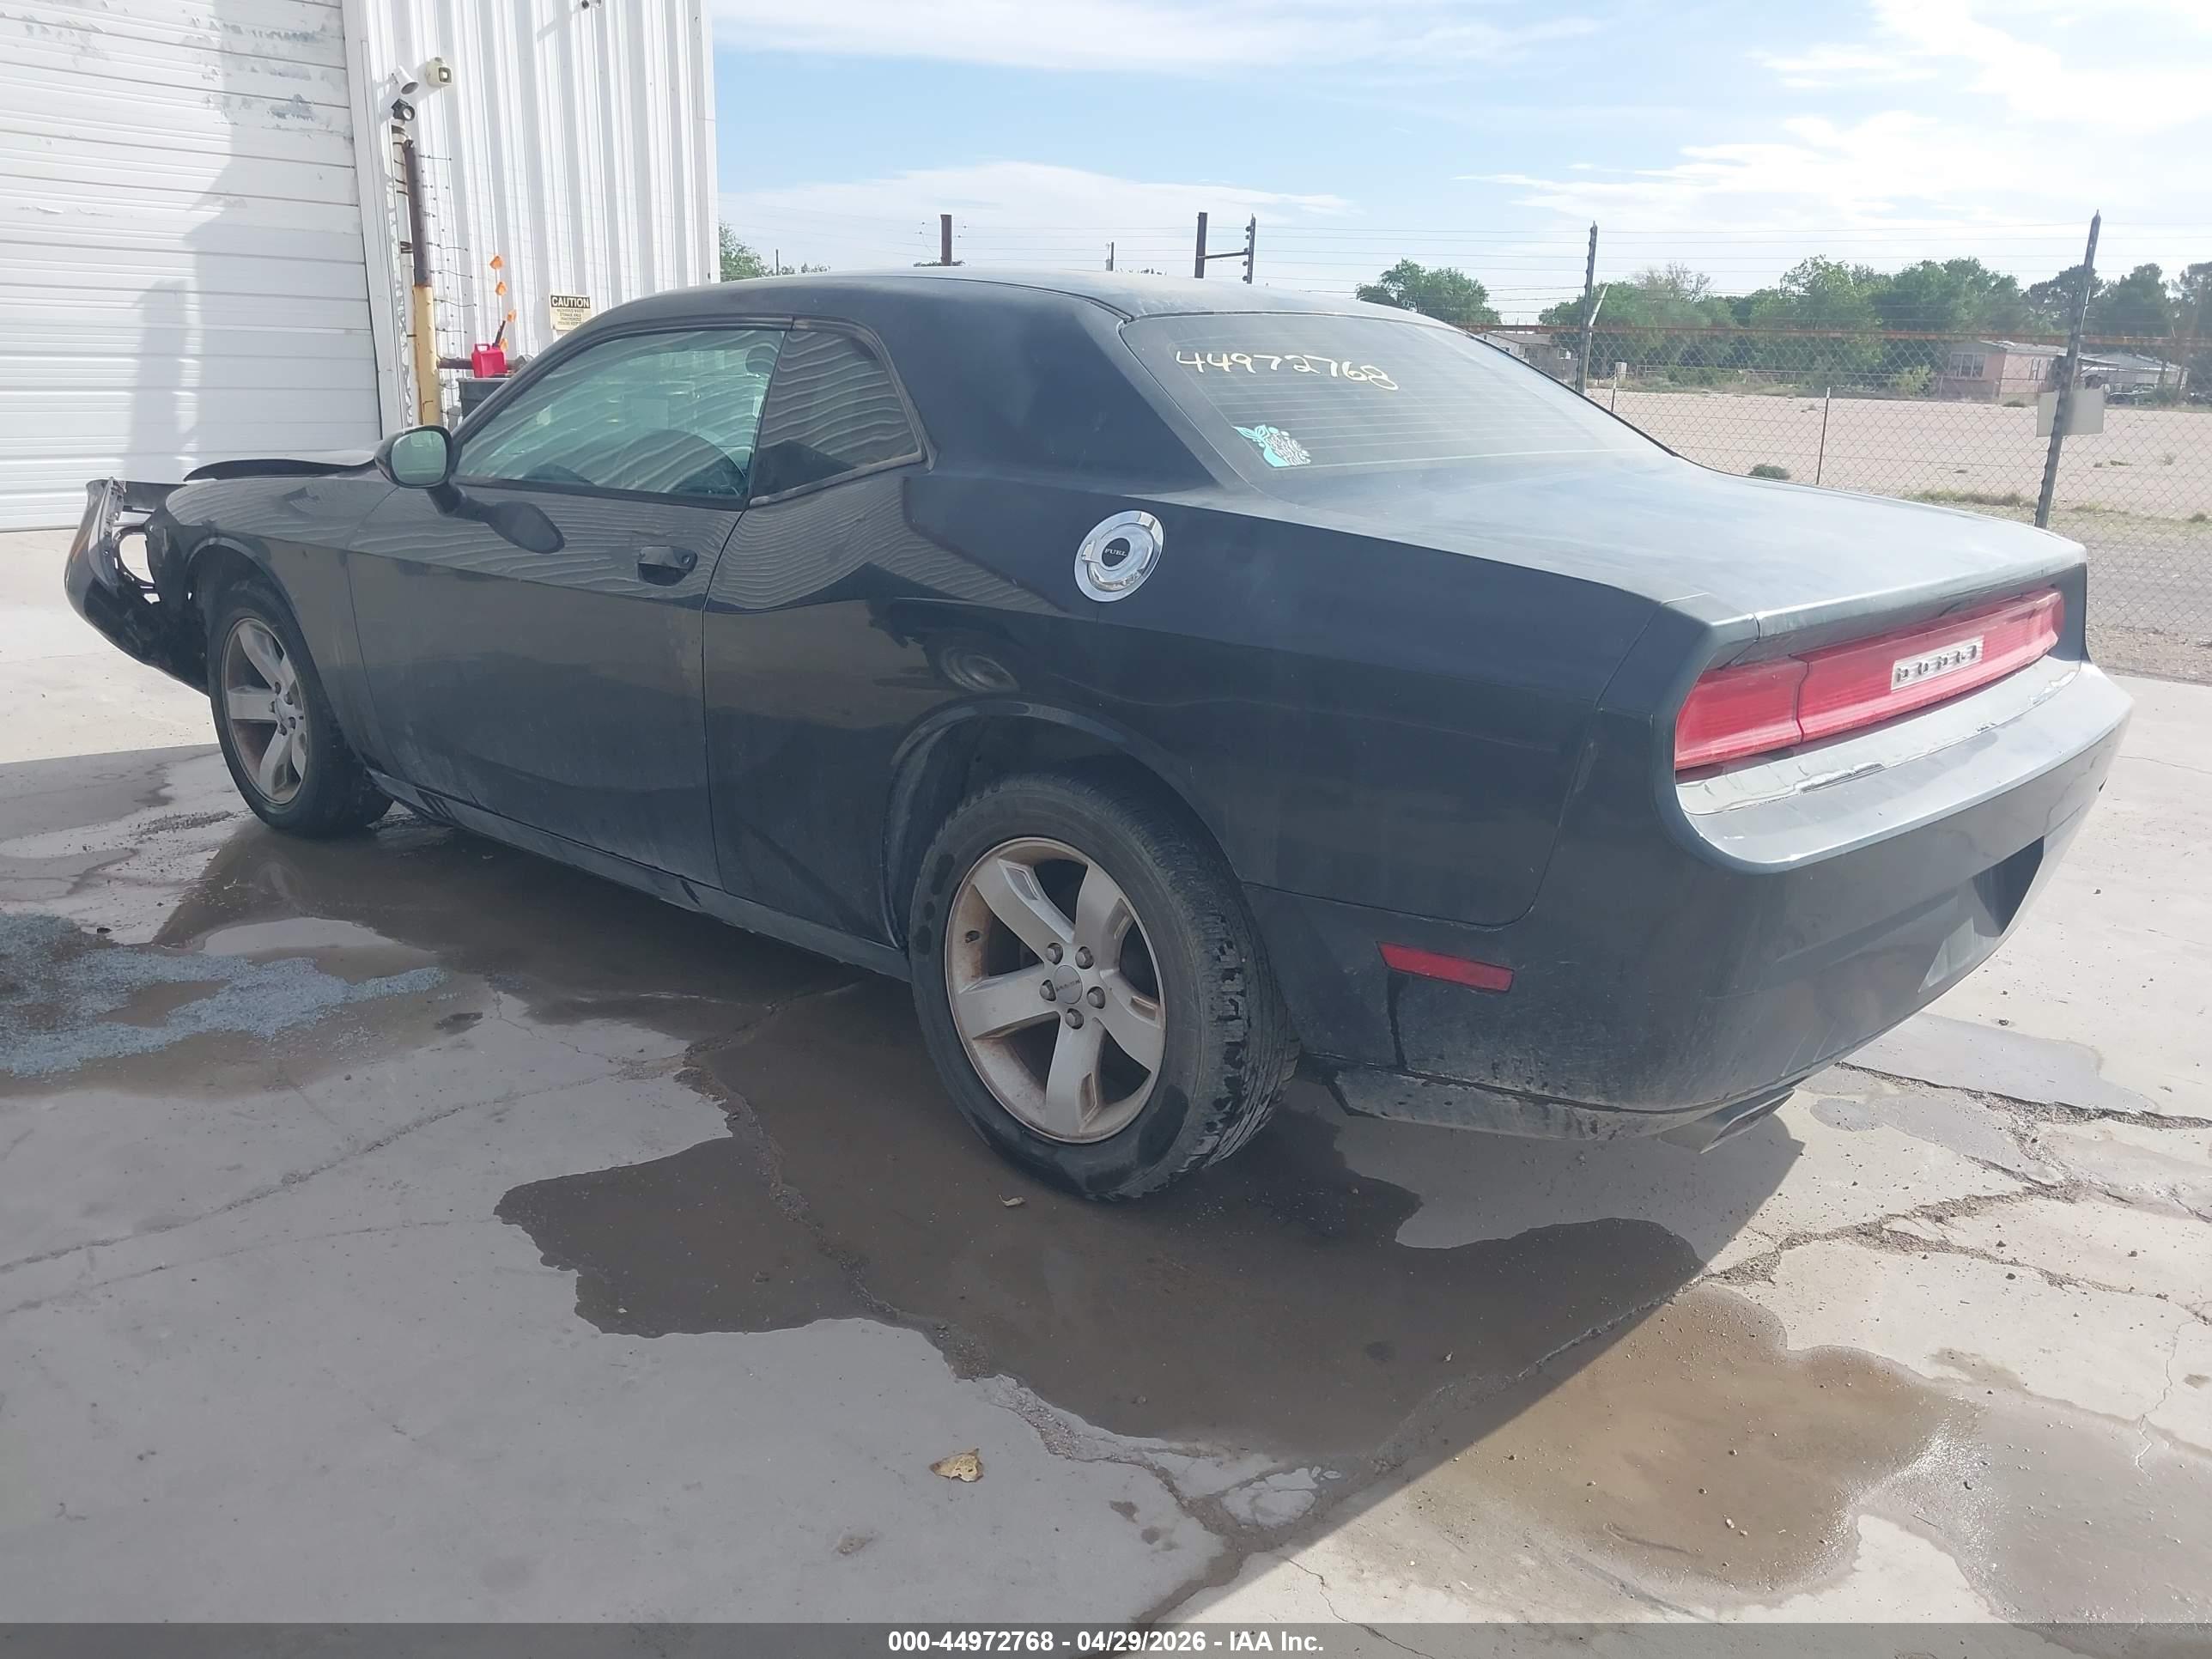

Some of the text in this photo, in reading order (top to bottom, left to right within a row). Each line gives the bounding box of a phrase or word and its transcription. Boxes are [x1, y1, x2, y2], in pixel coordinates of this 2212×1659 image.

[552, 296, 589, 307] CAUTION
[1176, 350, 1400, 391] 44972768
[1103, 548, 1127, 556] FUEL
